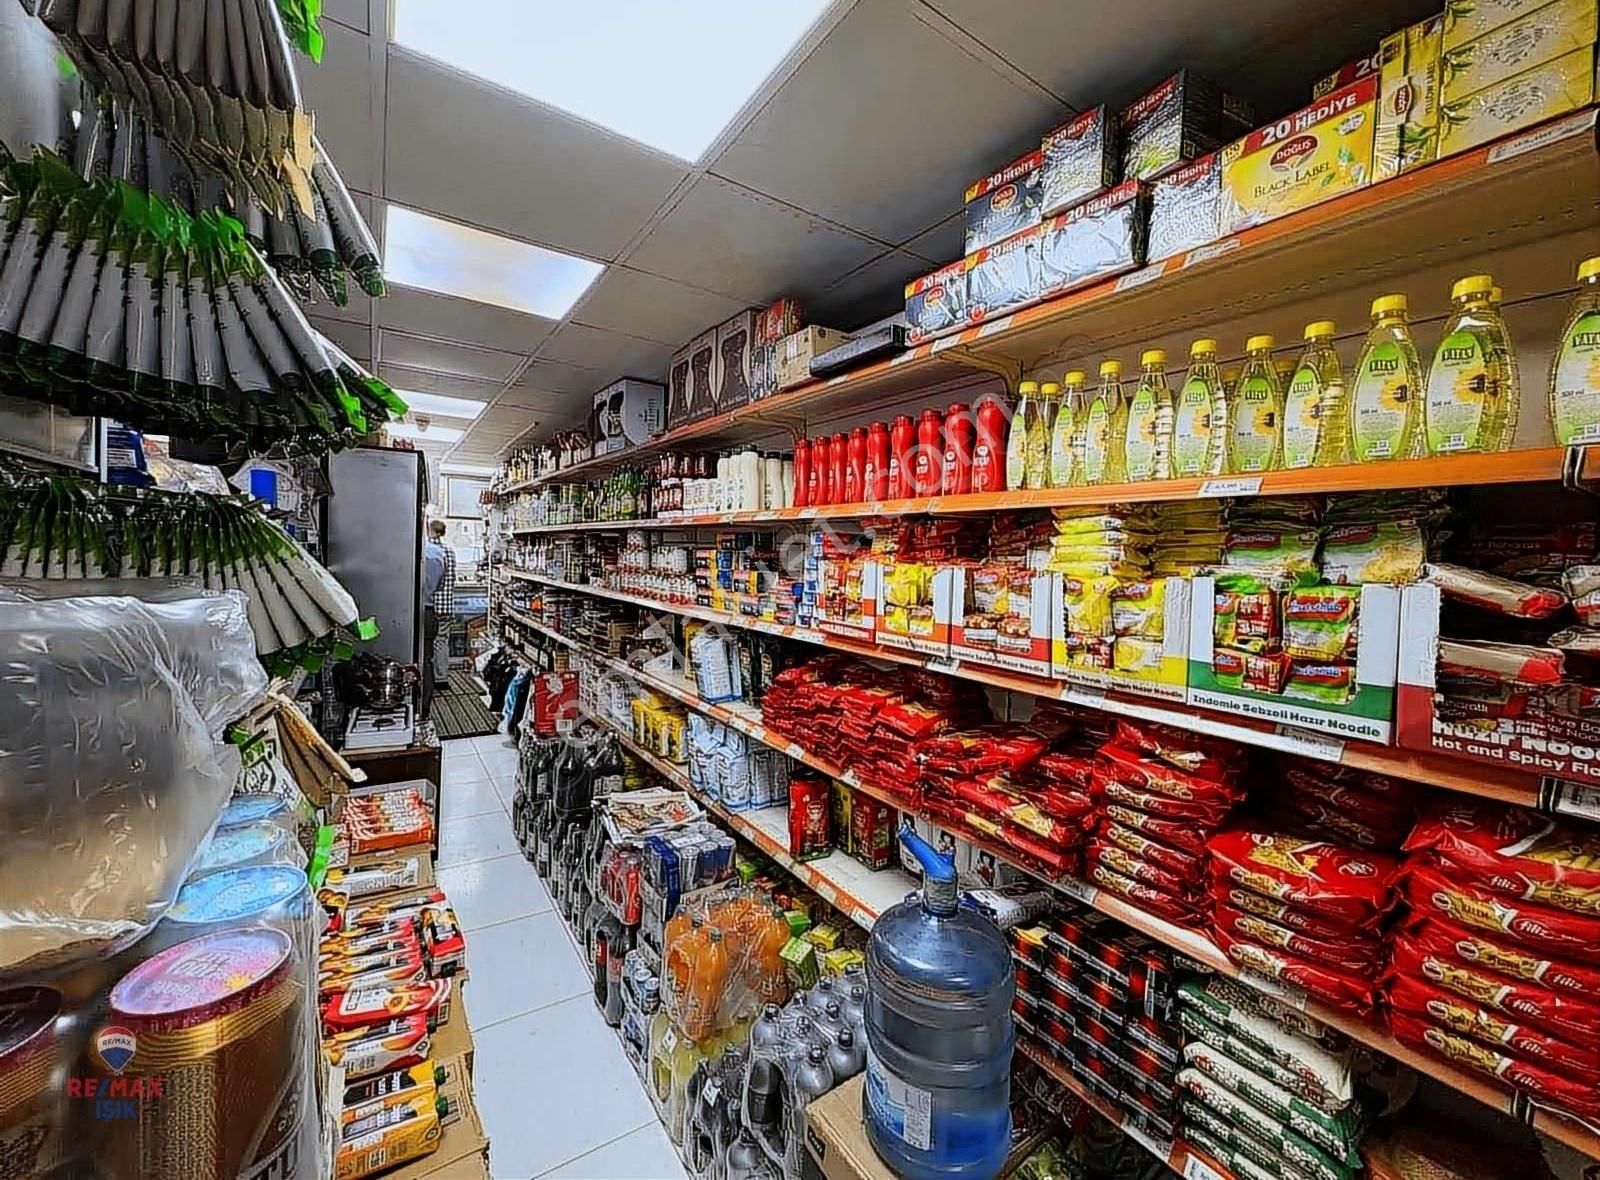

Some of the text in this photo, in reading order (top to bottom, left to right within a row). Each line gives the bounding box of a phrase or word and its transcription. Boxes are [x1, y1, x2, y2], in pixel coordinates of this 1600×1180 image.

[1261, 92, 1358, 148] 20 HEDİYE
[1253, 160, 1332, 200] BLACK LABEL
[1193, 694, 1241, 711] Indomie
[1289, 711, 1327, 730] Hazır
[1327, 718, 1382, 738] Noodle
[1432, 736, 1463, 752] Hot
[1467, 744, 1504, 760] and
[1508, 751, 1566, 772] Spicy
[1490, 875, 1518, 891] filiz
[1519, 919, 1550, 937] filiz
[1552, 973, 1584, 990] filiz
[1512, 998, 1542, 1016] filiz
[1519, 1038, 1549, 1056] filiz
[1514, 1072, 1543, 1090] filiz
